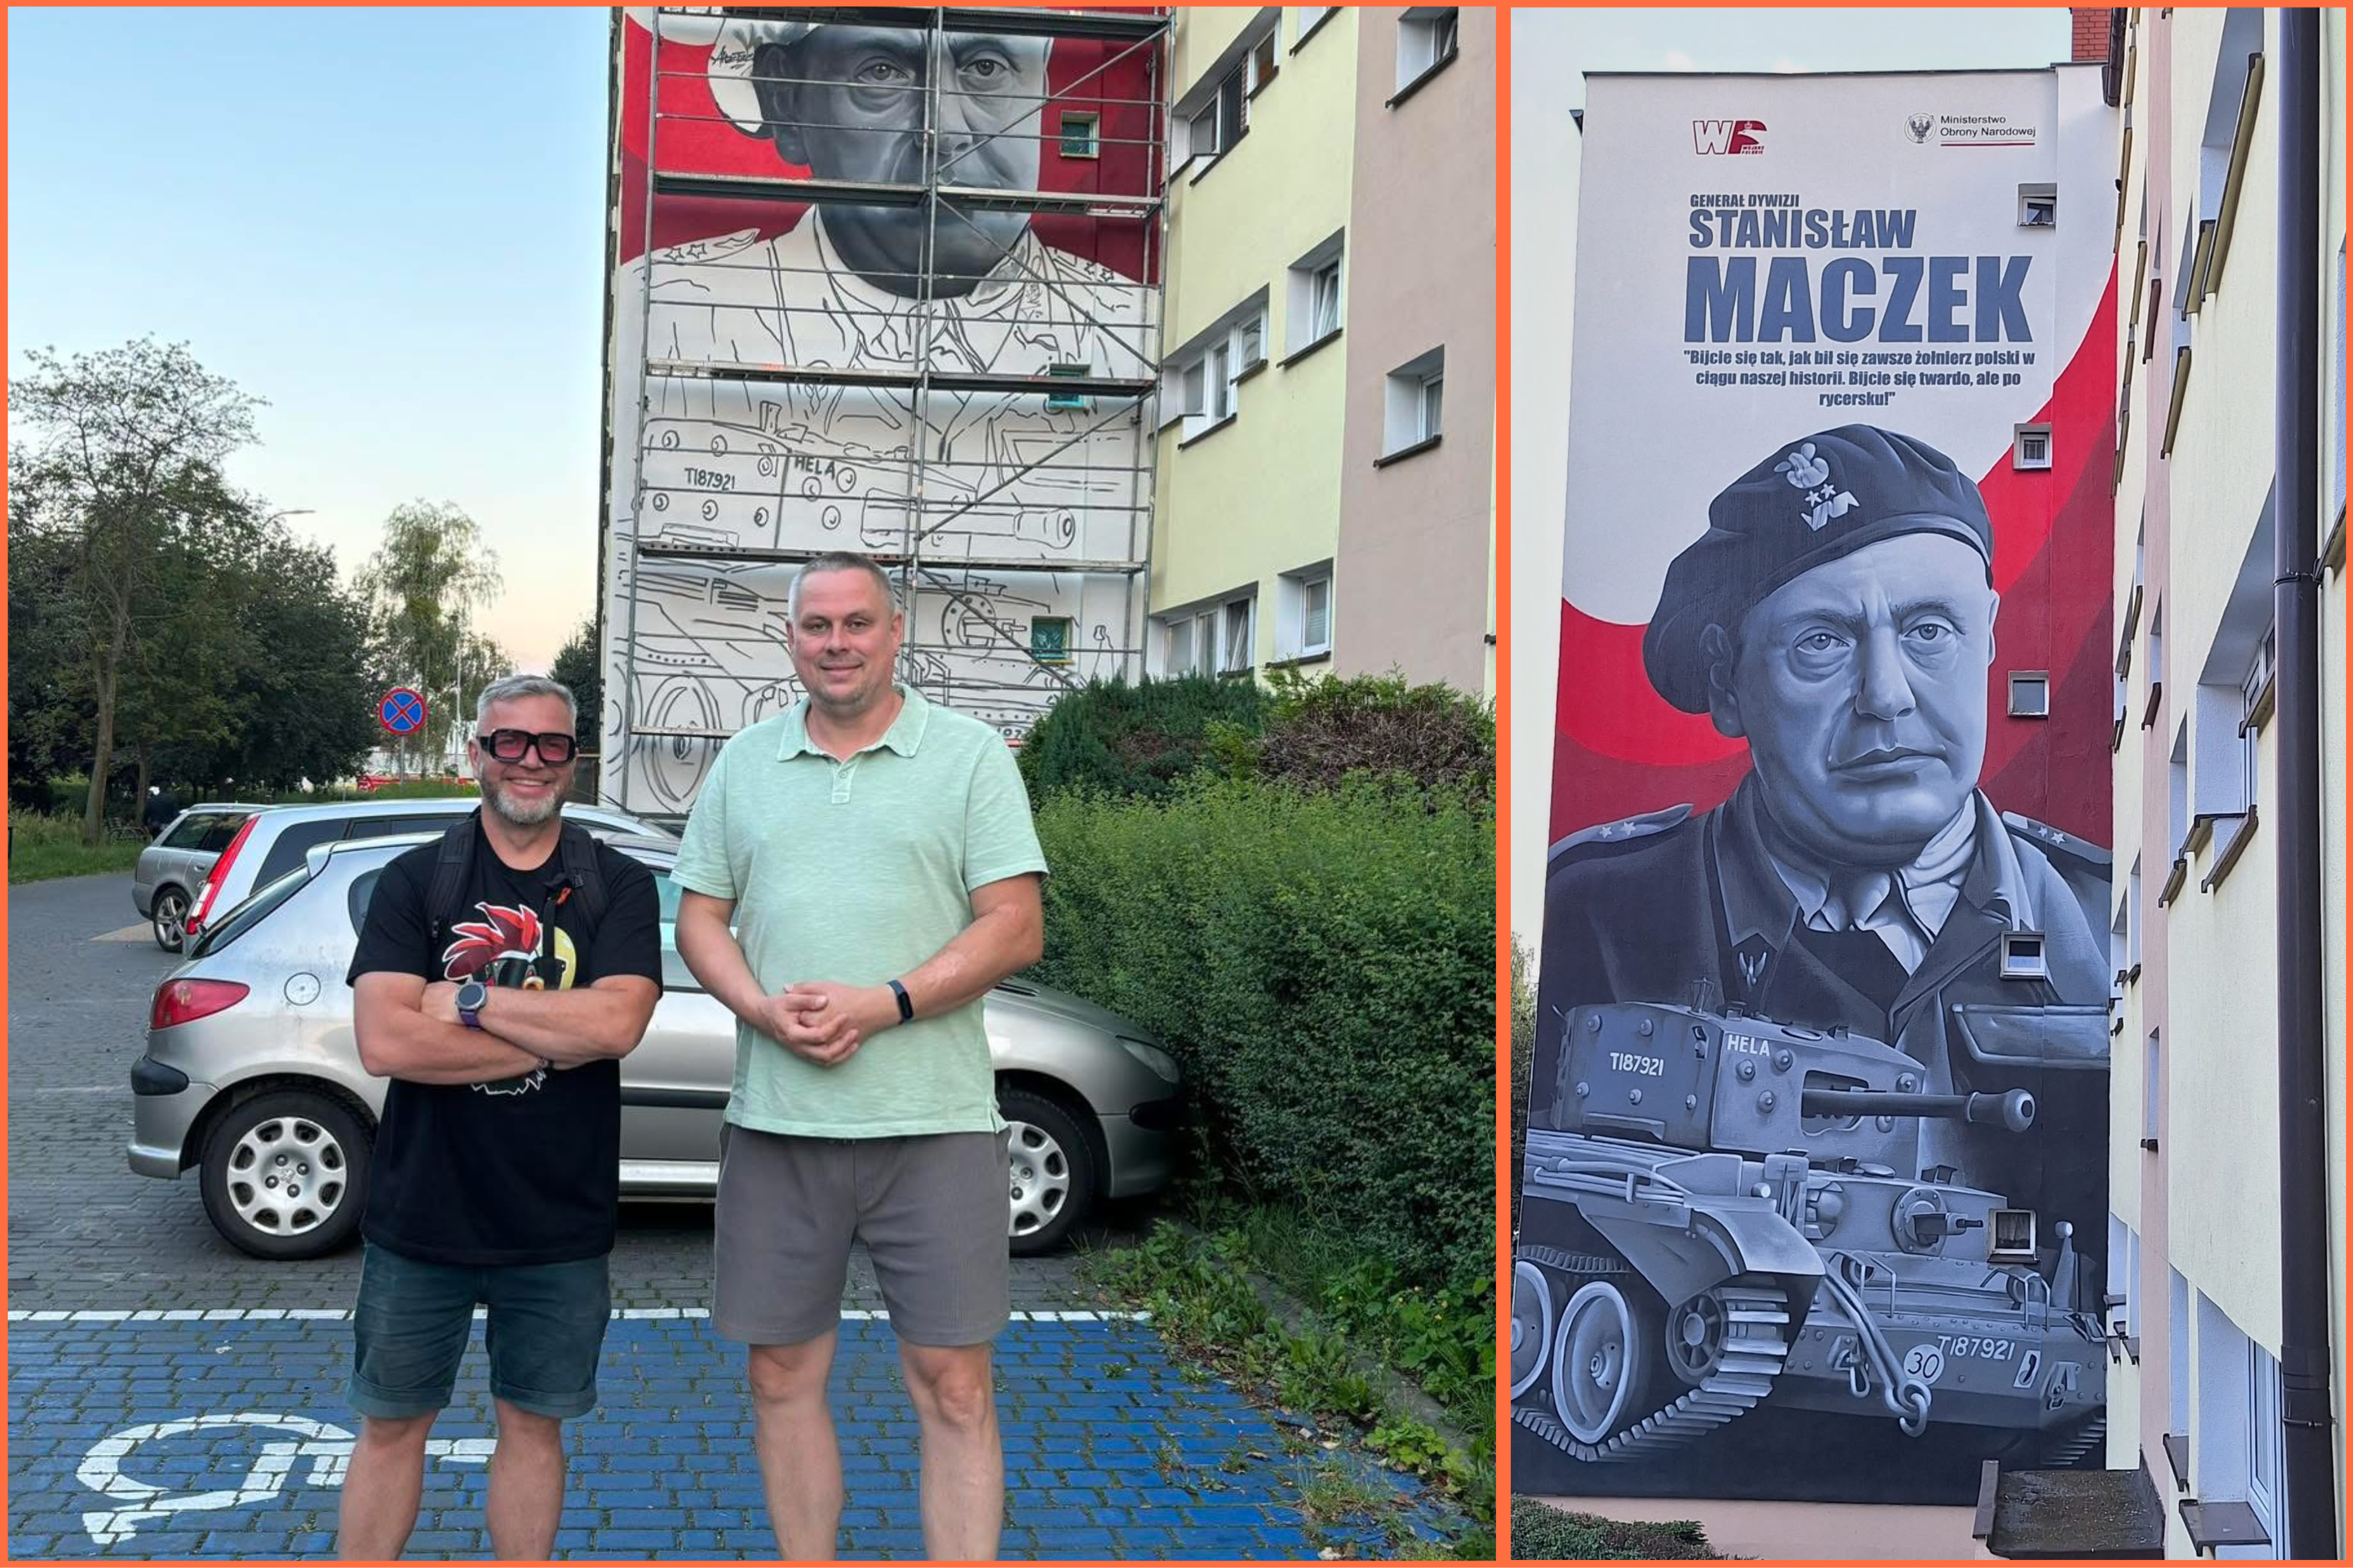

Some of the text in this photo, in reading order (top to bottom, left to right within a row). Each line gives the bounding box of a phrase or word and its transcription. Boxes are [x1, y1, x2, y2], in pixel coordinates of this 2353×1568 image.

[1941, 115, 2006, 124] Ministerstwo
[1940, 126, 2036, 138] Obrony Narodowej
[1690, 194, 1799, 207] GENERAŁ DYWIZJI
[1689, 209, 1917, 249] STANISŁAW
[1684, 256, 2034, 343] MACZEK
[1684, 350, 2035, 367] "Bijcie się tak, jak bił się zawsze żołnierz polski w
[1696, 370, 2021, 388] ciągu naszej historii. Bijcie się twardo, ale po
[1819, 391, 1896, 407] rycersku!"
[795, 455, 835, 479] HELA
[1727, 1034, 1770, 1057] HELA
[1907, 1351, 1940, 1379] 30
